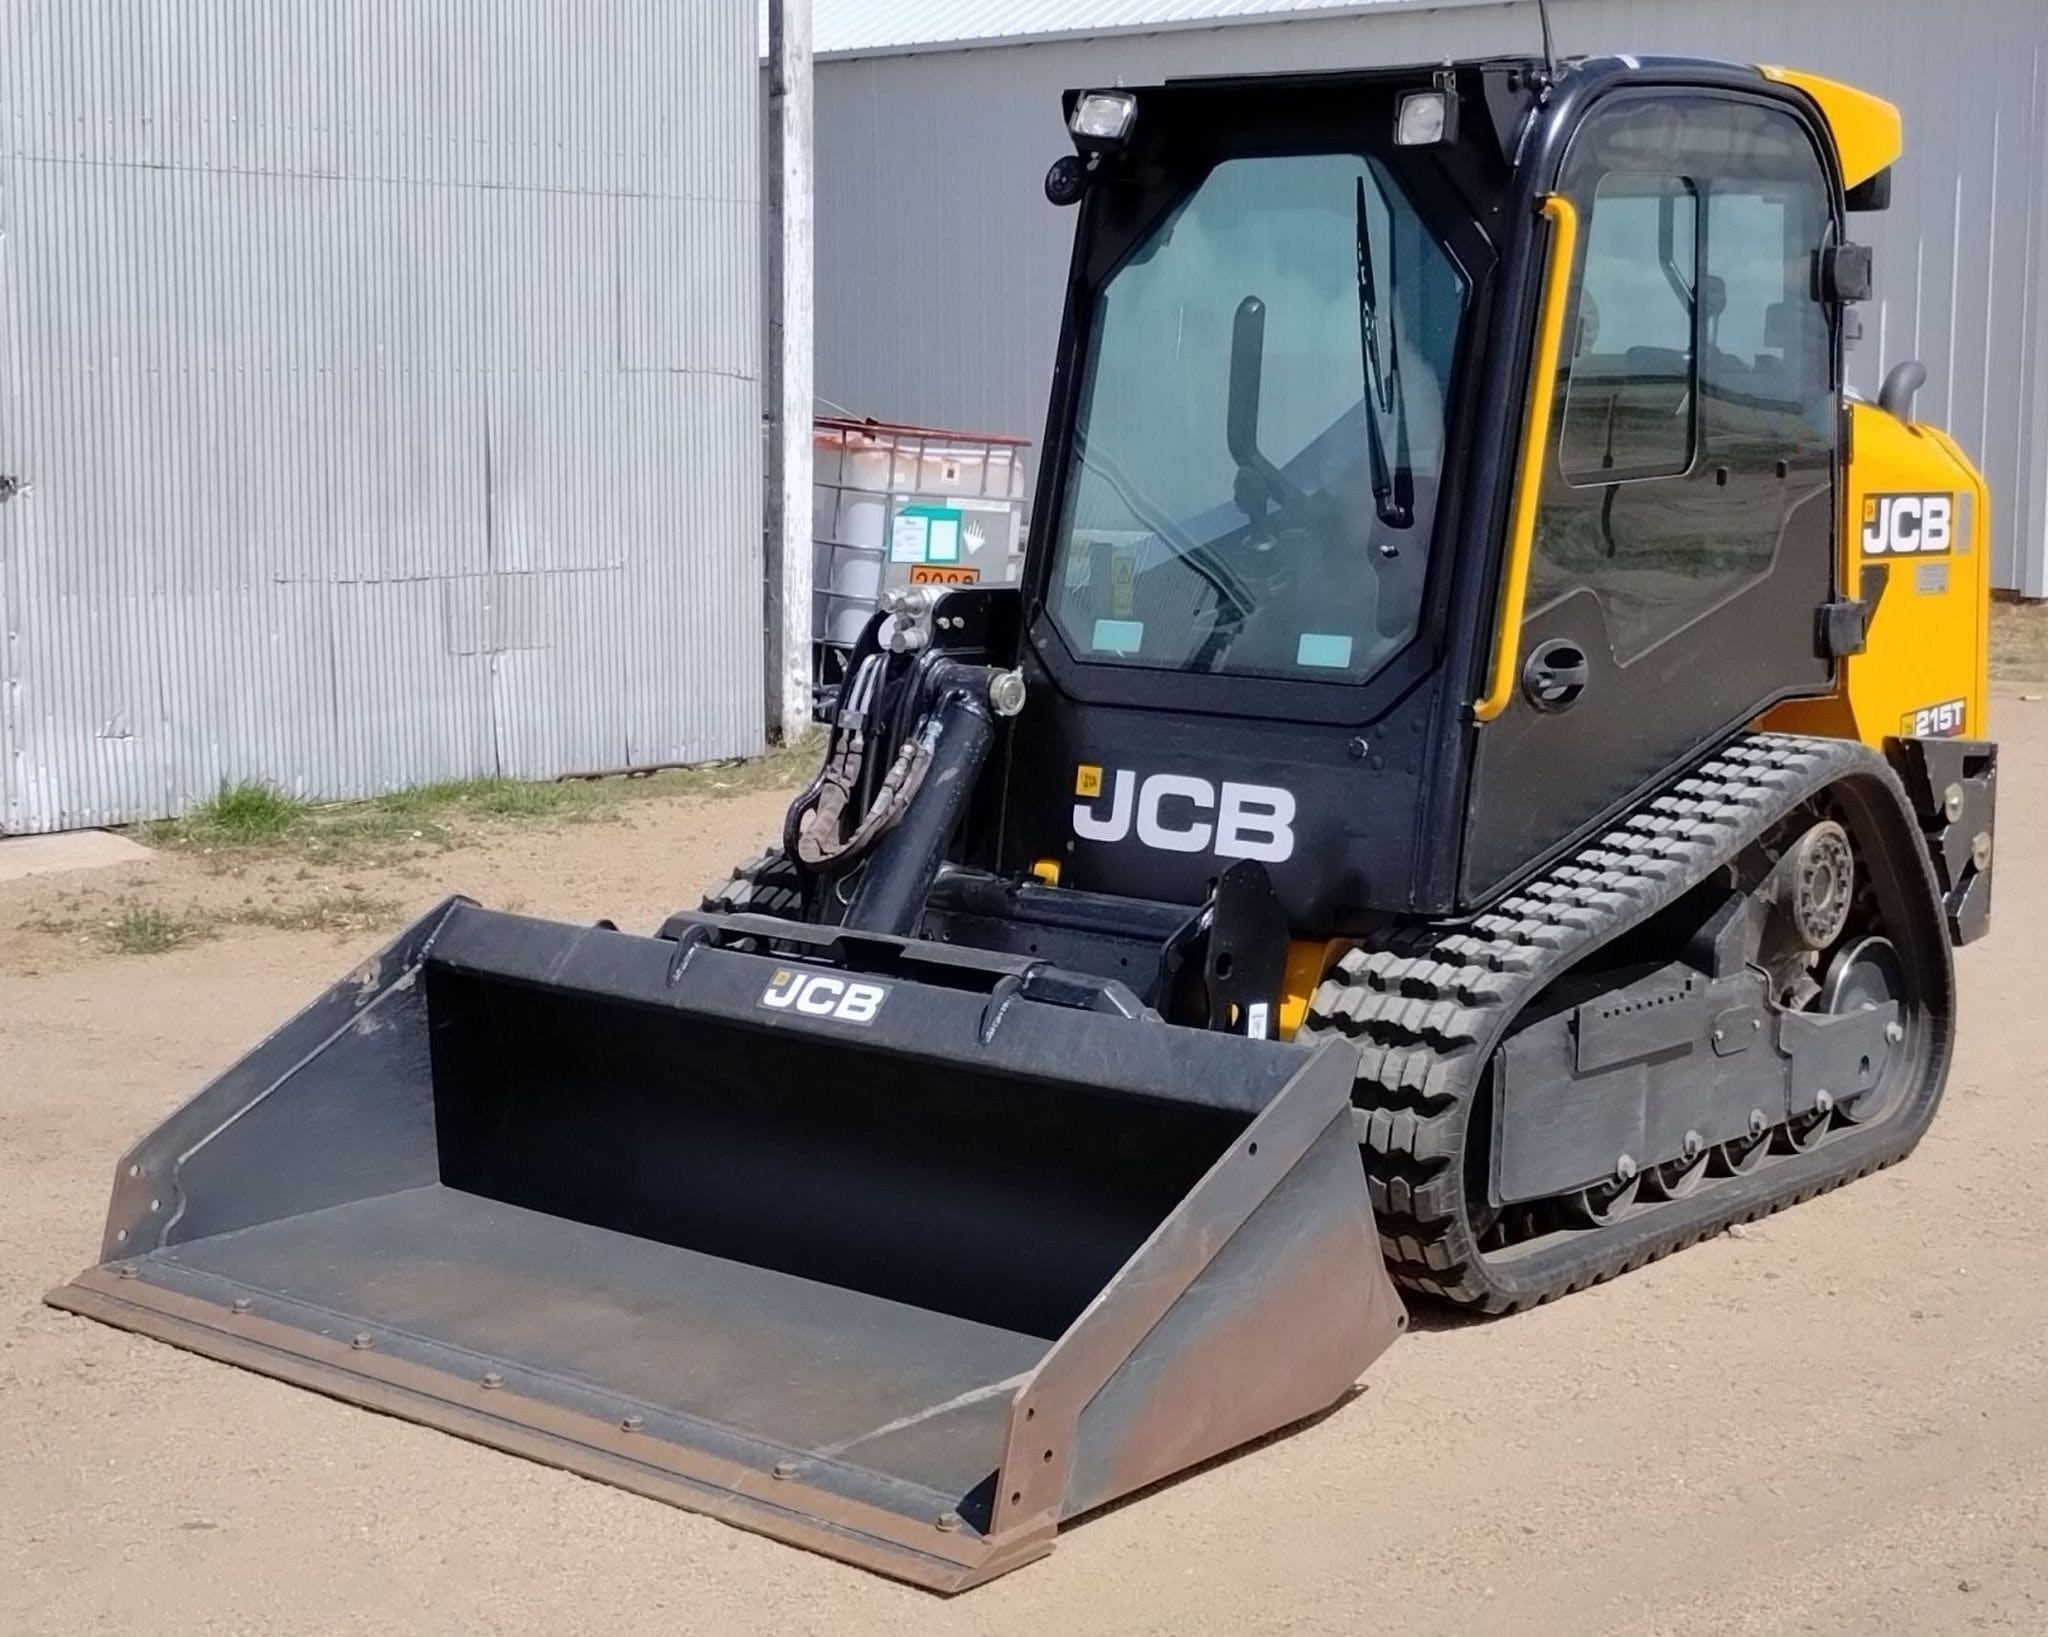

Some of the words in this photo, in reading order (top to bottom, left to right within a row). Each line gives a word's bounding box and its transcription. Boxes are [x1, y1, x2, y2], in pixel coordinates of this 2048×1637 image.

[1863, 497, 1951, 554] JCB
[1915, 699, 1965, 737] 215T
[1072, 769, 1296, 863] JCB
[762, 974, 885, 1022] JCB
